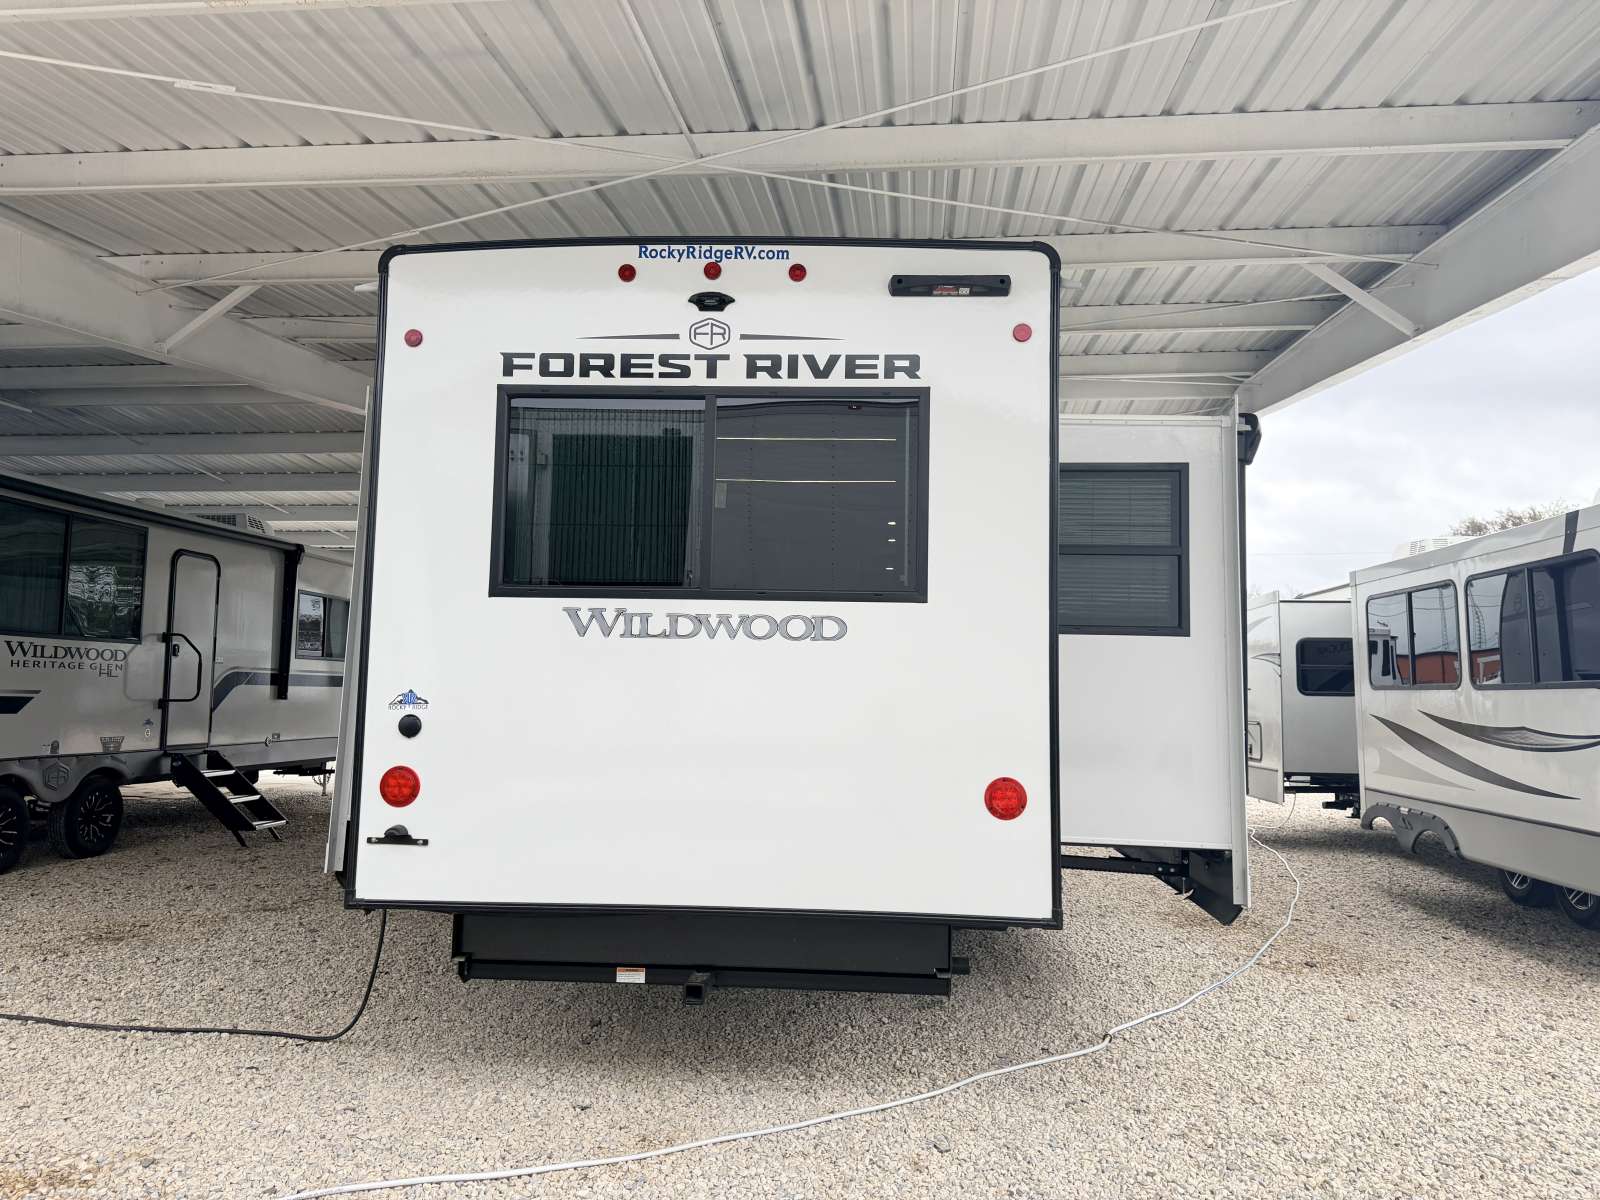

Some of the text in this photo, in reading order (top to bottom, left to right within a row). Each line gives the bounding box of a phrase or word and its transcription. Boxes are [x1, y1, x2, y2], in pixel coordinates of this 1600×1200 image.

[638, 245, 790, 263] RockyRidgeRV.com
[501, 352, 921, 380] FOREST RIVER
[562, 606, 848, 641] WILDWOOD
[5, 640, 127, 662] WILDWOOD
[10, 659, 86, 670] HERITAGE
